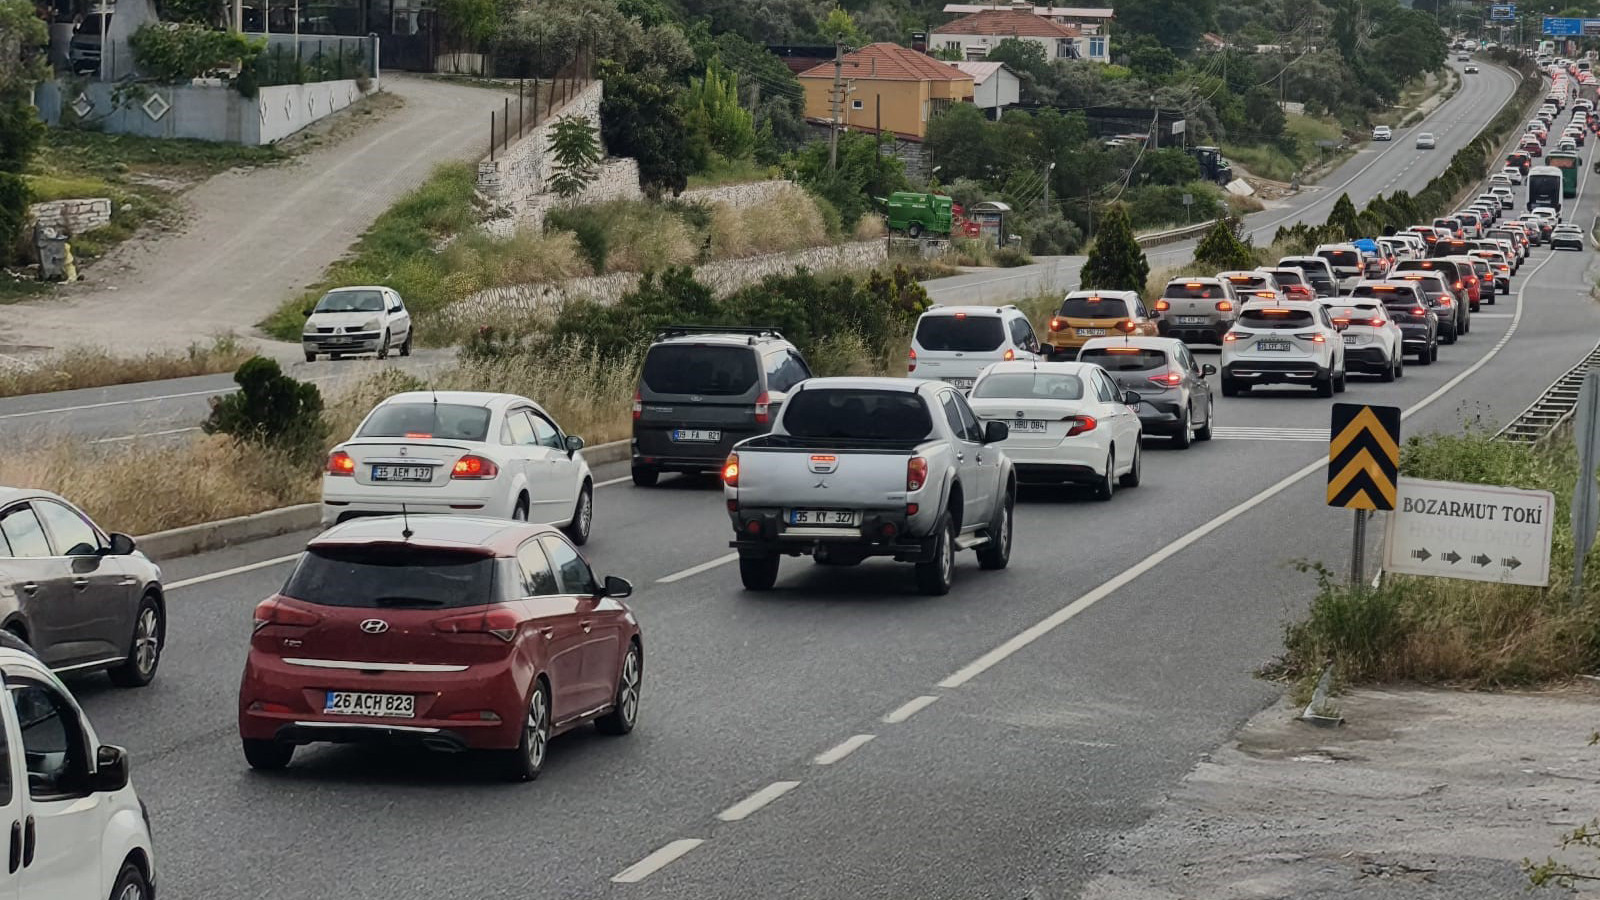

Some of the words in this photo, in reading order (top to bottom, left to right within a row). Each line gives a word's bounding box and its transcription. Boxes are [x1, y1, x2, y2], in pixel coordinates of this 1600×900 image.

[377, 467, 388, 477] 35
[393, 467, 410, 477] AEM
[414, 468, 430, 478] 137
[796, 511, 808, 522] 35
[835, 512, 852, 523] 327
[1402, 497, 1497, 520] BOZARMUT
[1502, 505, 1543, 525] TOKİ
[333, 693, 352, 708] 26
[353, 695, 383, 710] ACH
[385, 696, 413, 711] 823
